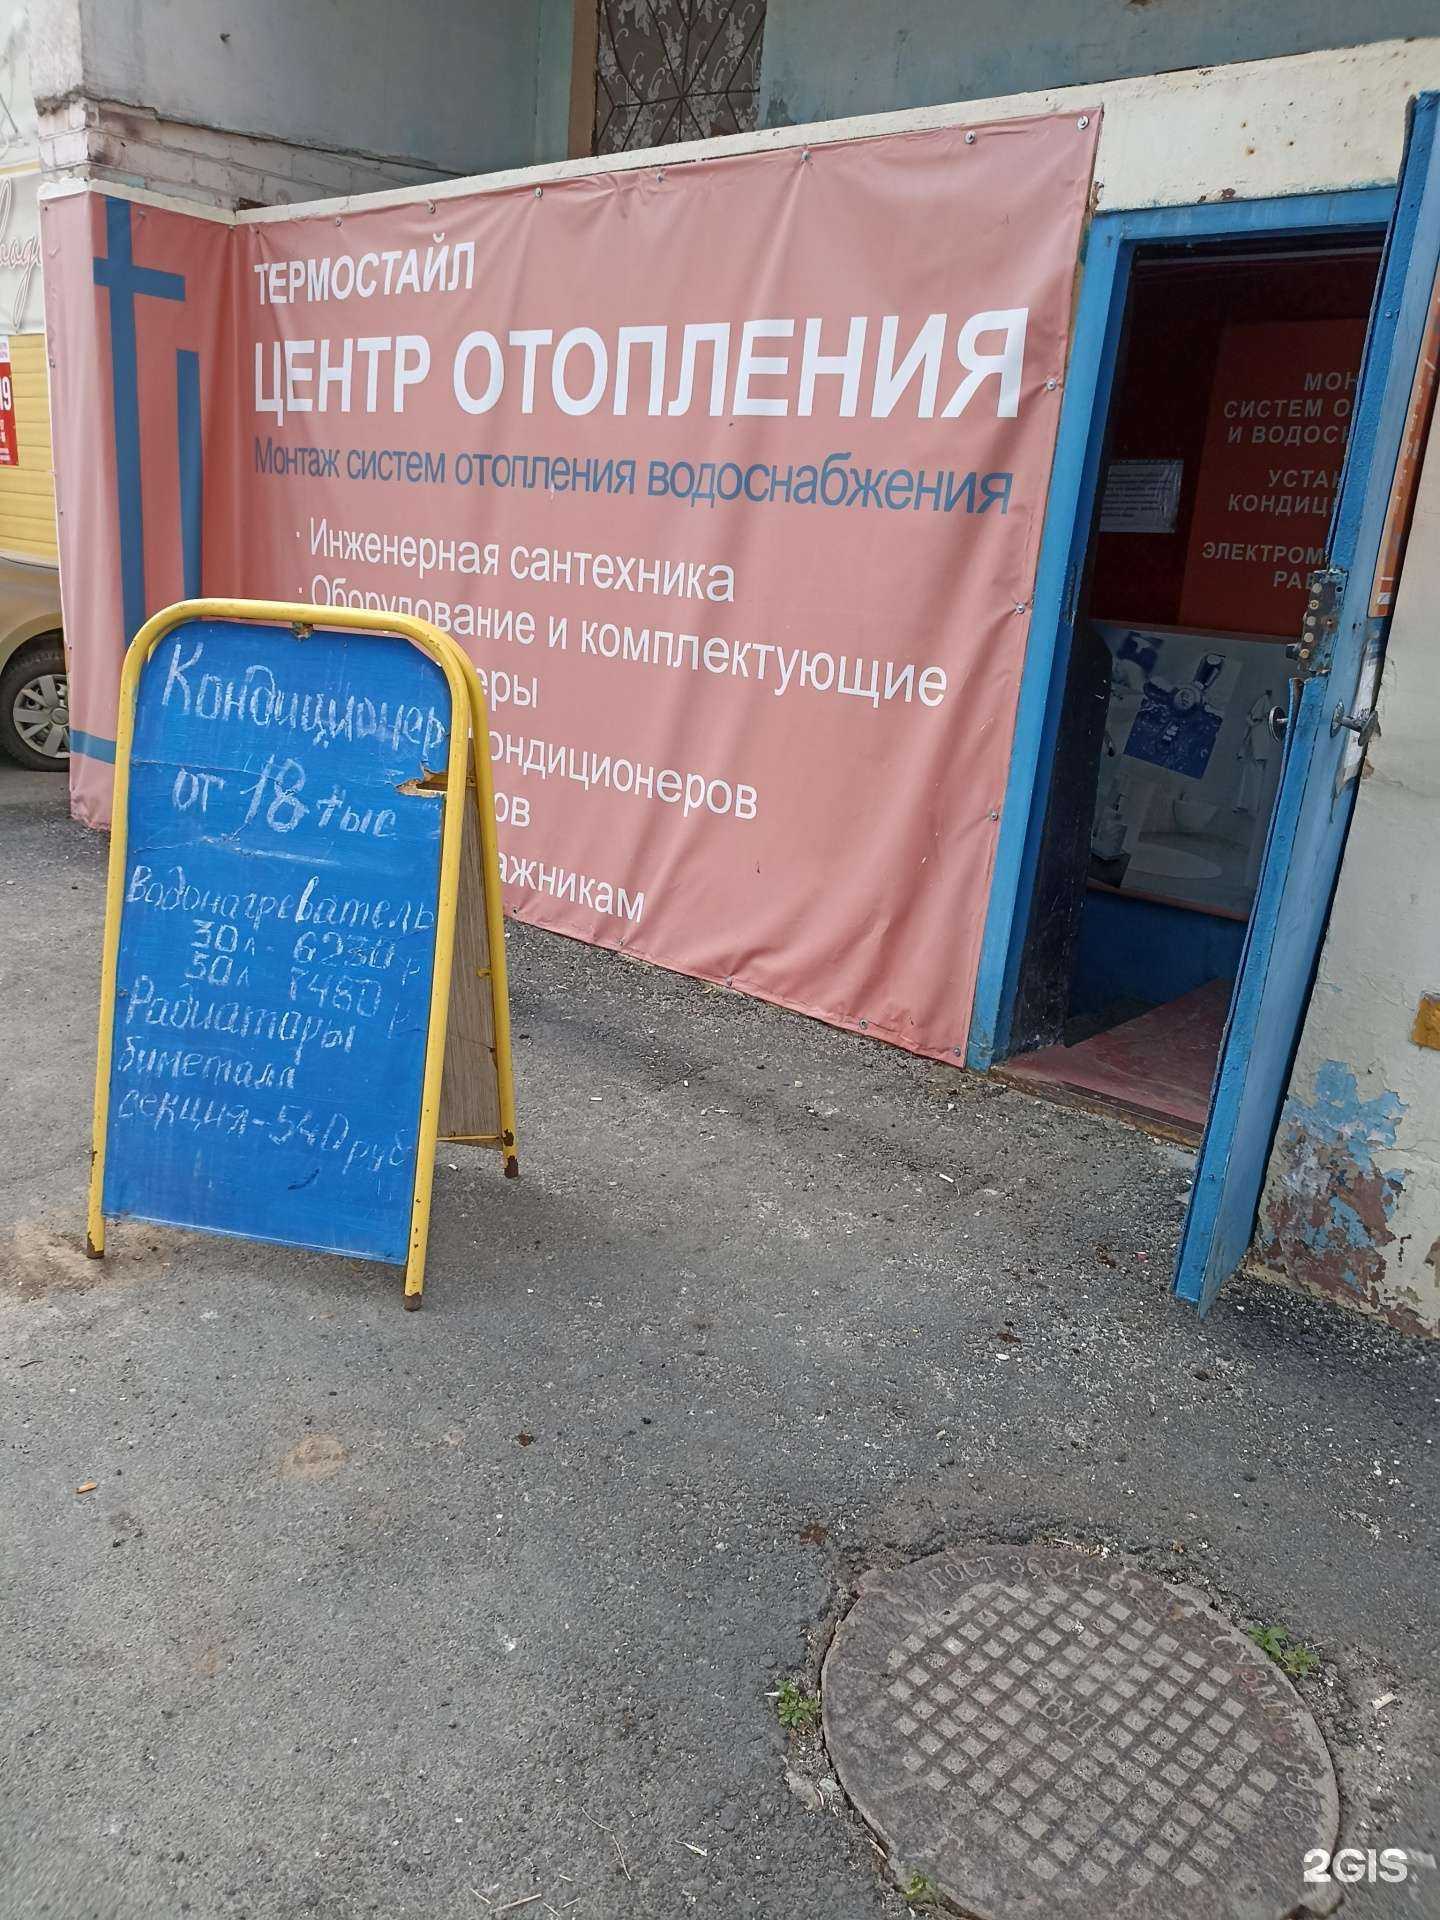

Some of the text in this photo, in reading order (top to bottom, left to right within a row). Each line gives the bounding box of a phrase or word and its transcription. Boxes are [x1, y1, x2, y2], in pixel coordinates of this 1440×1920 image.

[254, 232, 475, 305] ТЕРМОСТАЙЛ
[255, 307, 1029, 427] ЦЕНТР ОТОПЛЕНИЯ
[1304, 371, 1358, 391] МОН
[1224, 399, 1323, 419] СИСТЕМ
[1227, 426, 1349, 446] И ВОДОС
[254, 436, 1013, 515] Монтаж систем отопления водоснабжения
[1227, 493, 1331, 517] КОНДИЦ
[309, 517, 735, 602] Инженерная сантехника
[1201, 542, 1324, 565] ЭЛЕКТРОМ
[548, 615, 568, 650] и
[581, 620, 948, 708] комплектующие
[172, 753, 398, 838] от 18 тыс
[489, 729, 758, 820] ондиционеров
[498, 852, 645, 923] ажникам
